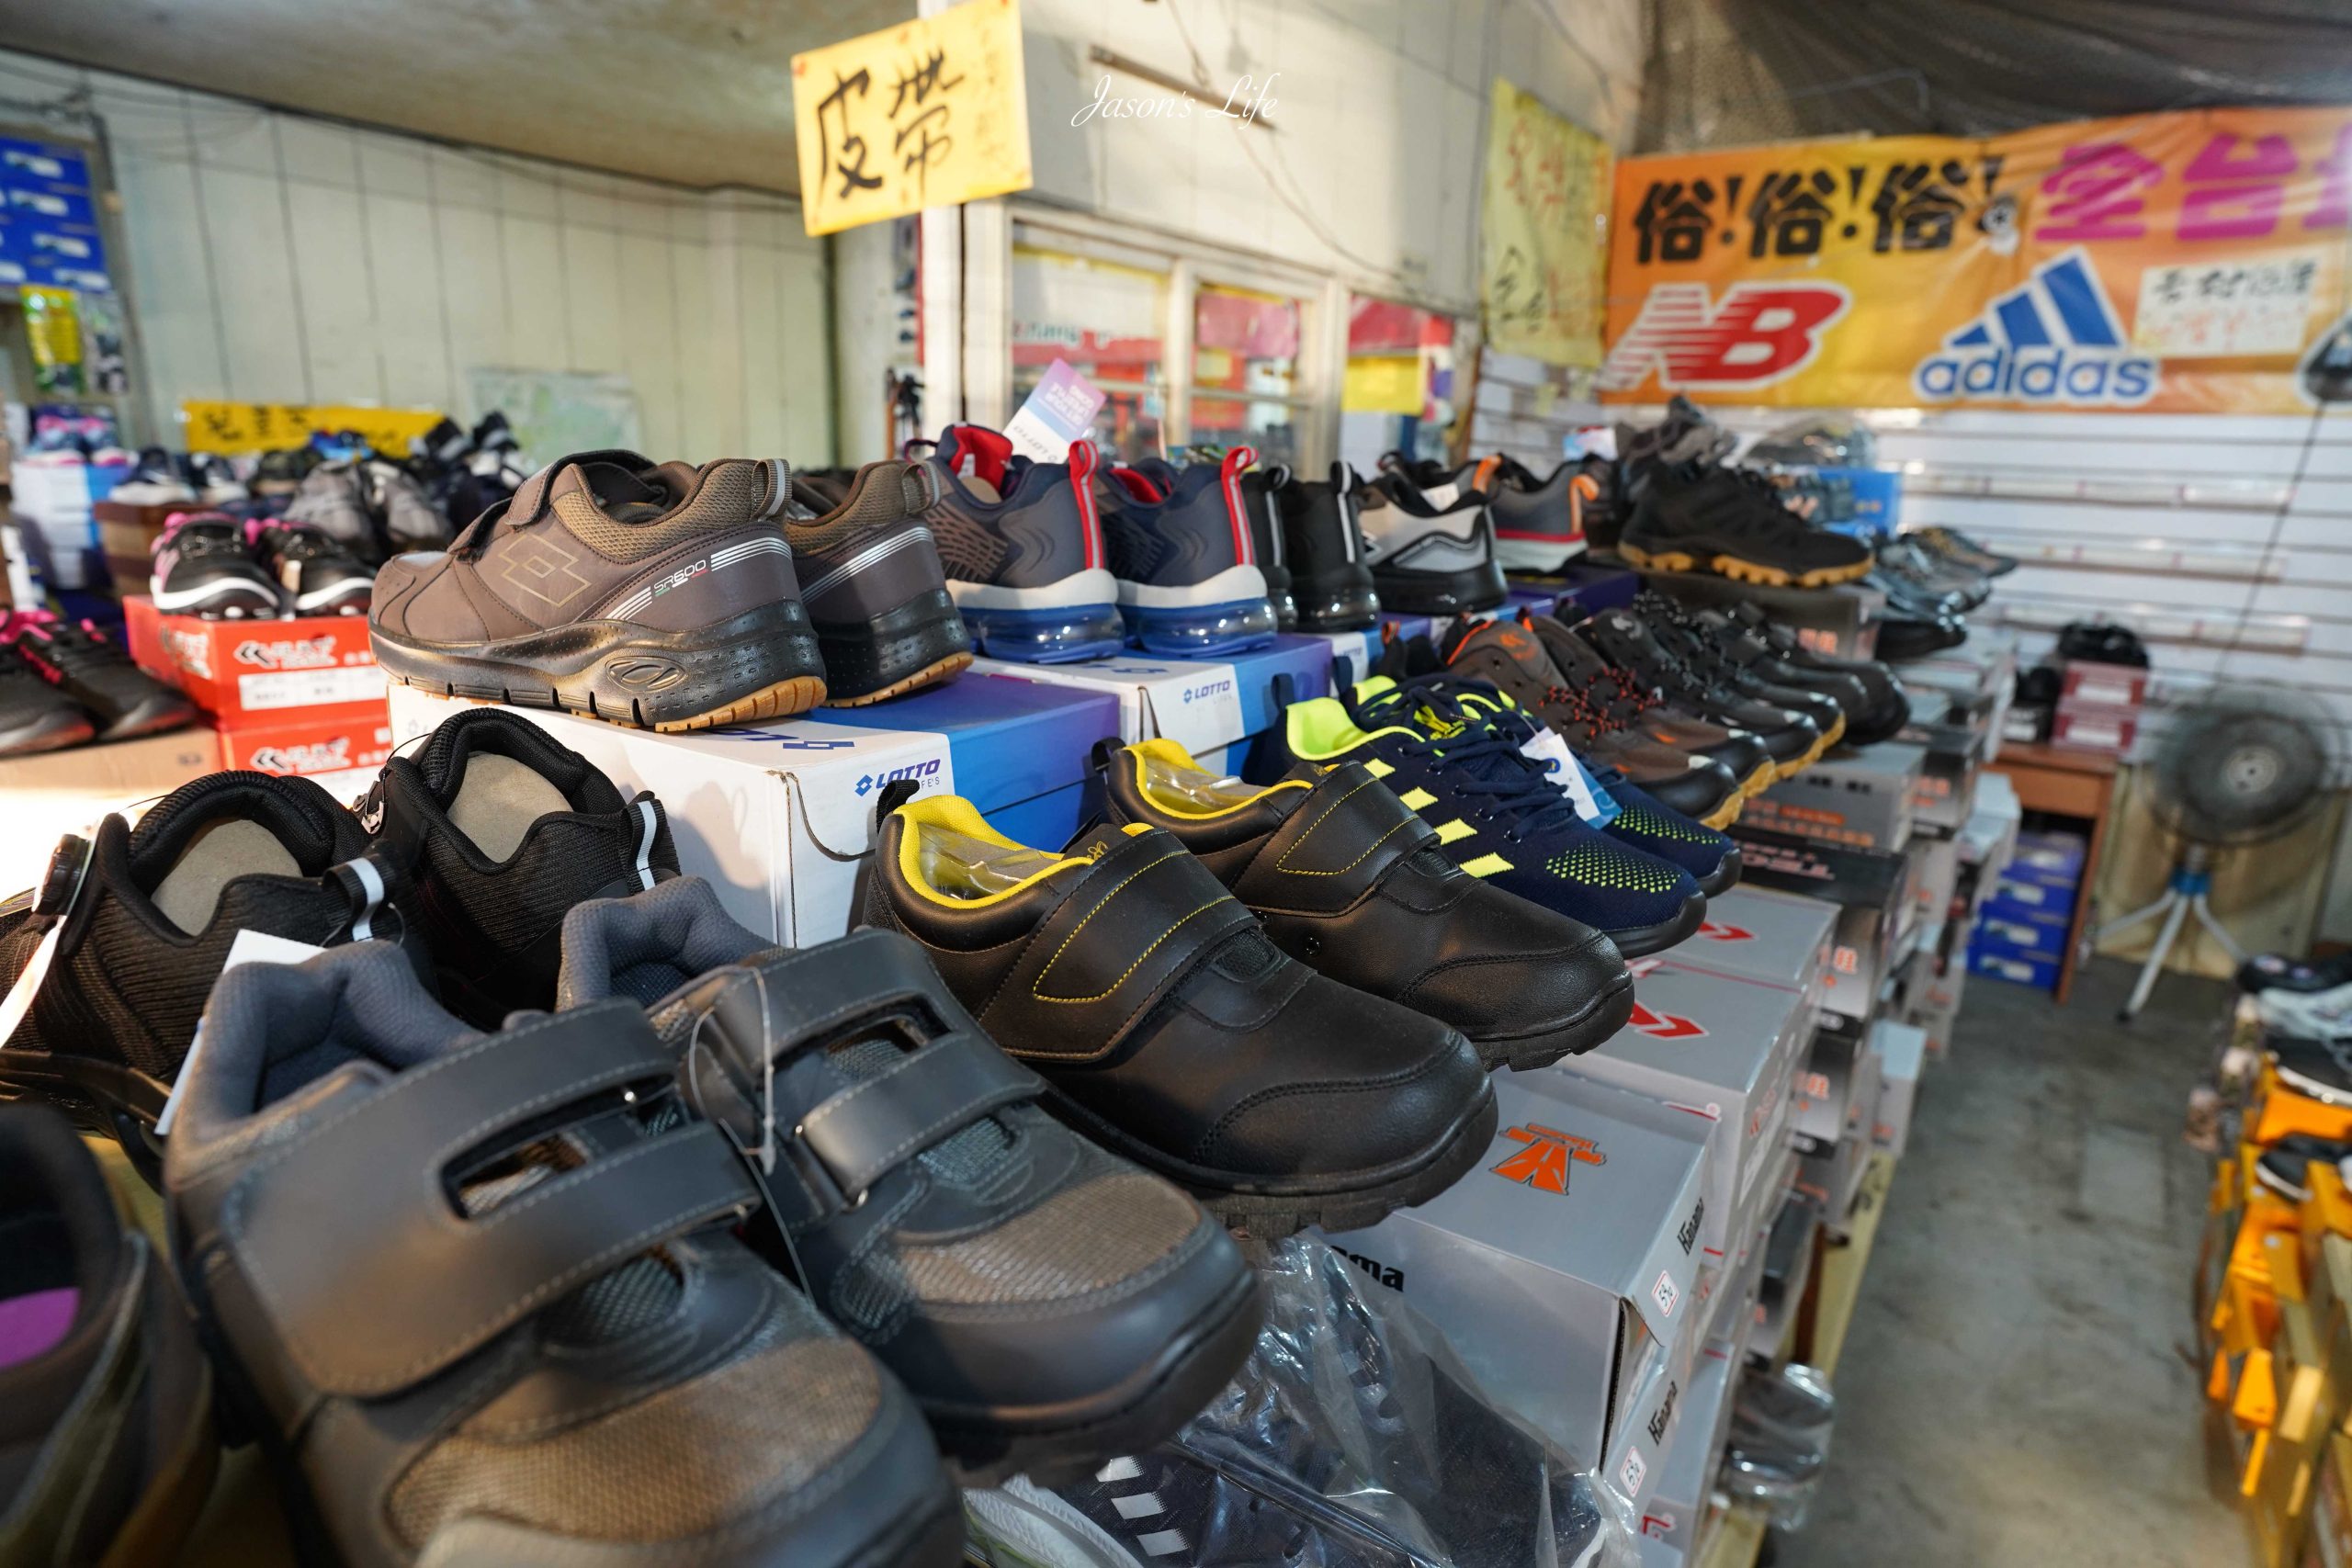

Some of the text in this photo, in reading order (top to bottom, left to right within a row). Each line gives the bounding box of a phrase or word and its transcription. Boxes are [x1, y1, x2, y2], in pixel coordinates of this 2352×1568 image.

[1918, 348, 2155, 399] adidas
[1194, 680, 1231, 699] LOTTO
[876, 759, 941, 789] LOTTO
